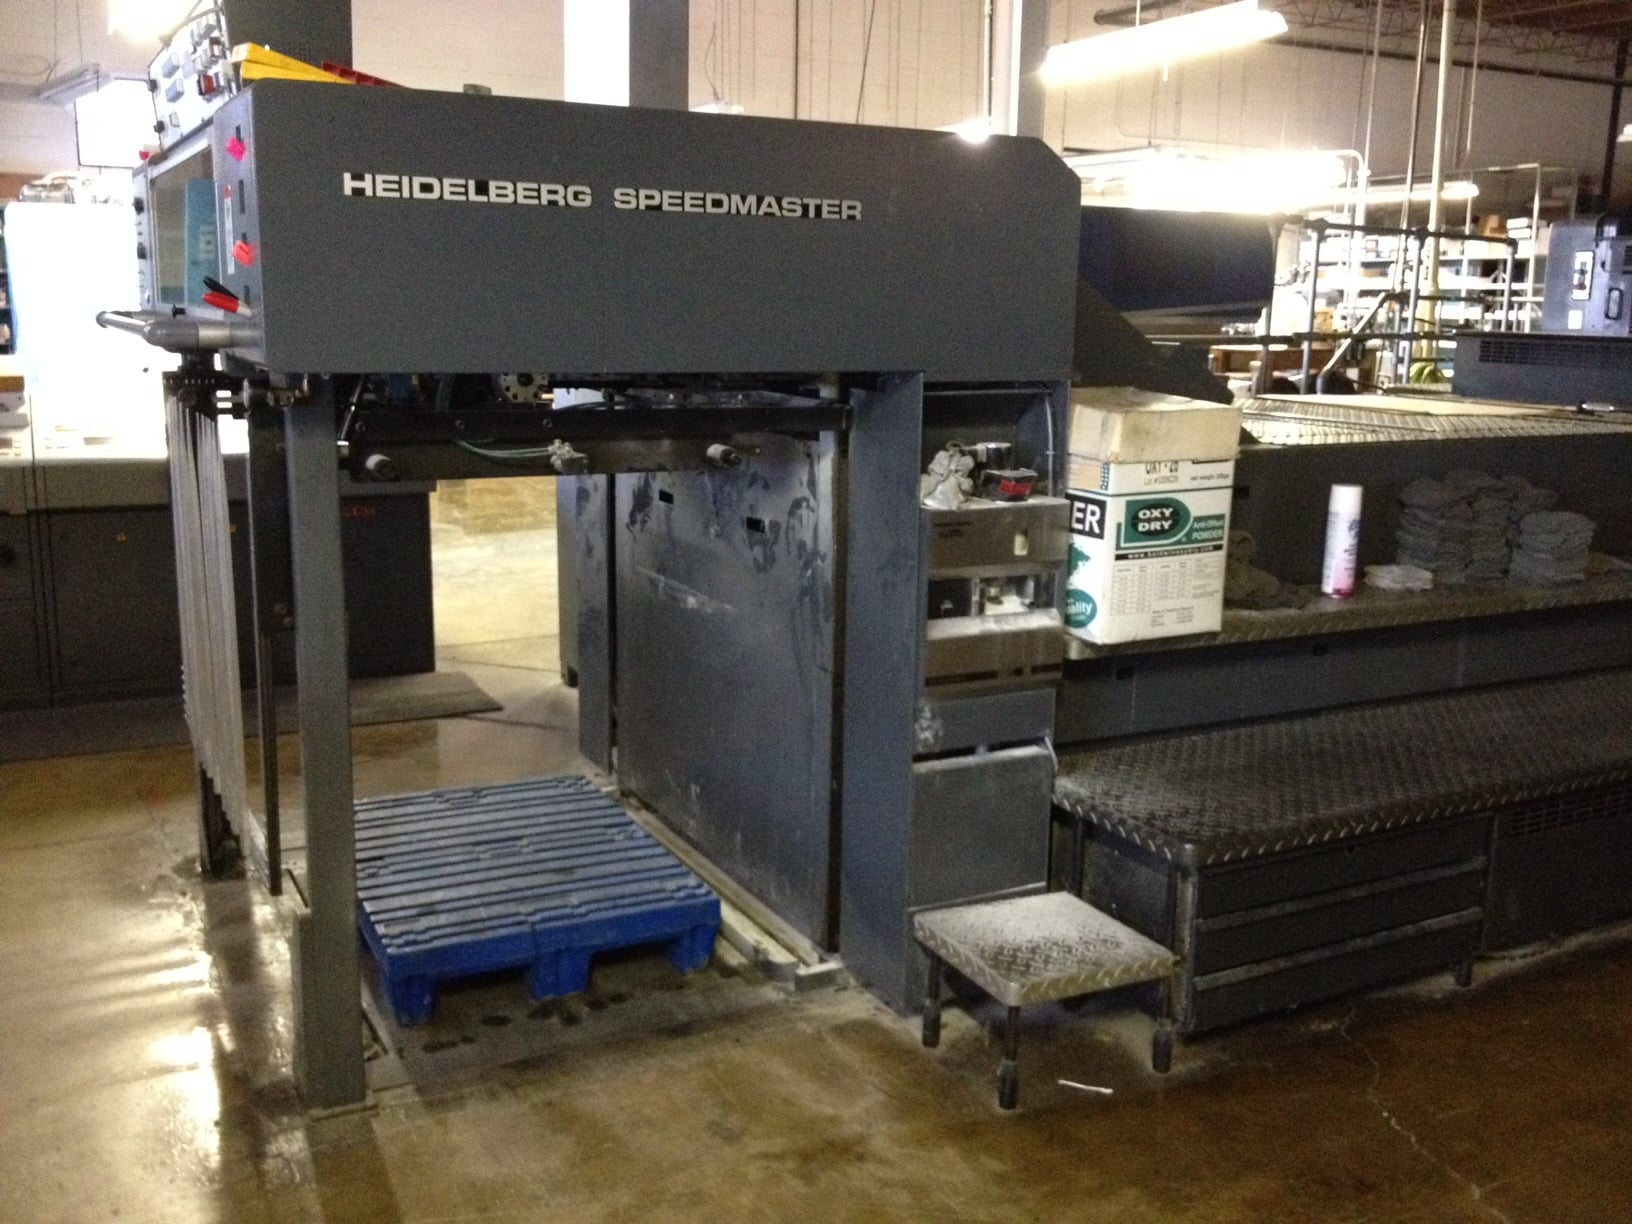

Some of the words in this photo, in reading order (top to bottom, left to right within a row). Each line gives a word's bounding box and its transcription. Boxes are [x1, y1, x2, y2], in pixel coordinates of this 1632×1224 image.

[342, 172, 592, 208] HEIDELBERG
[613, 187, 863, 221] SPEEDMASTER
[1071, 501, 1101, 534] ER
[1138, 507, 1174, 520] OXY
[1138, 520, 1174, 533] DRY
